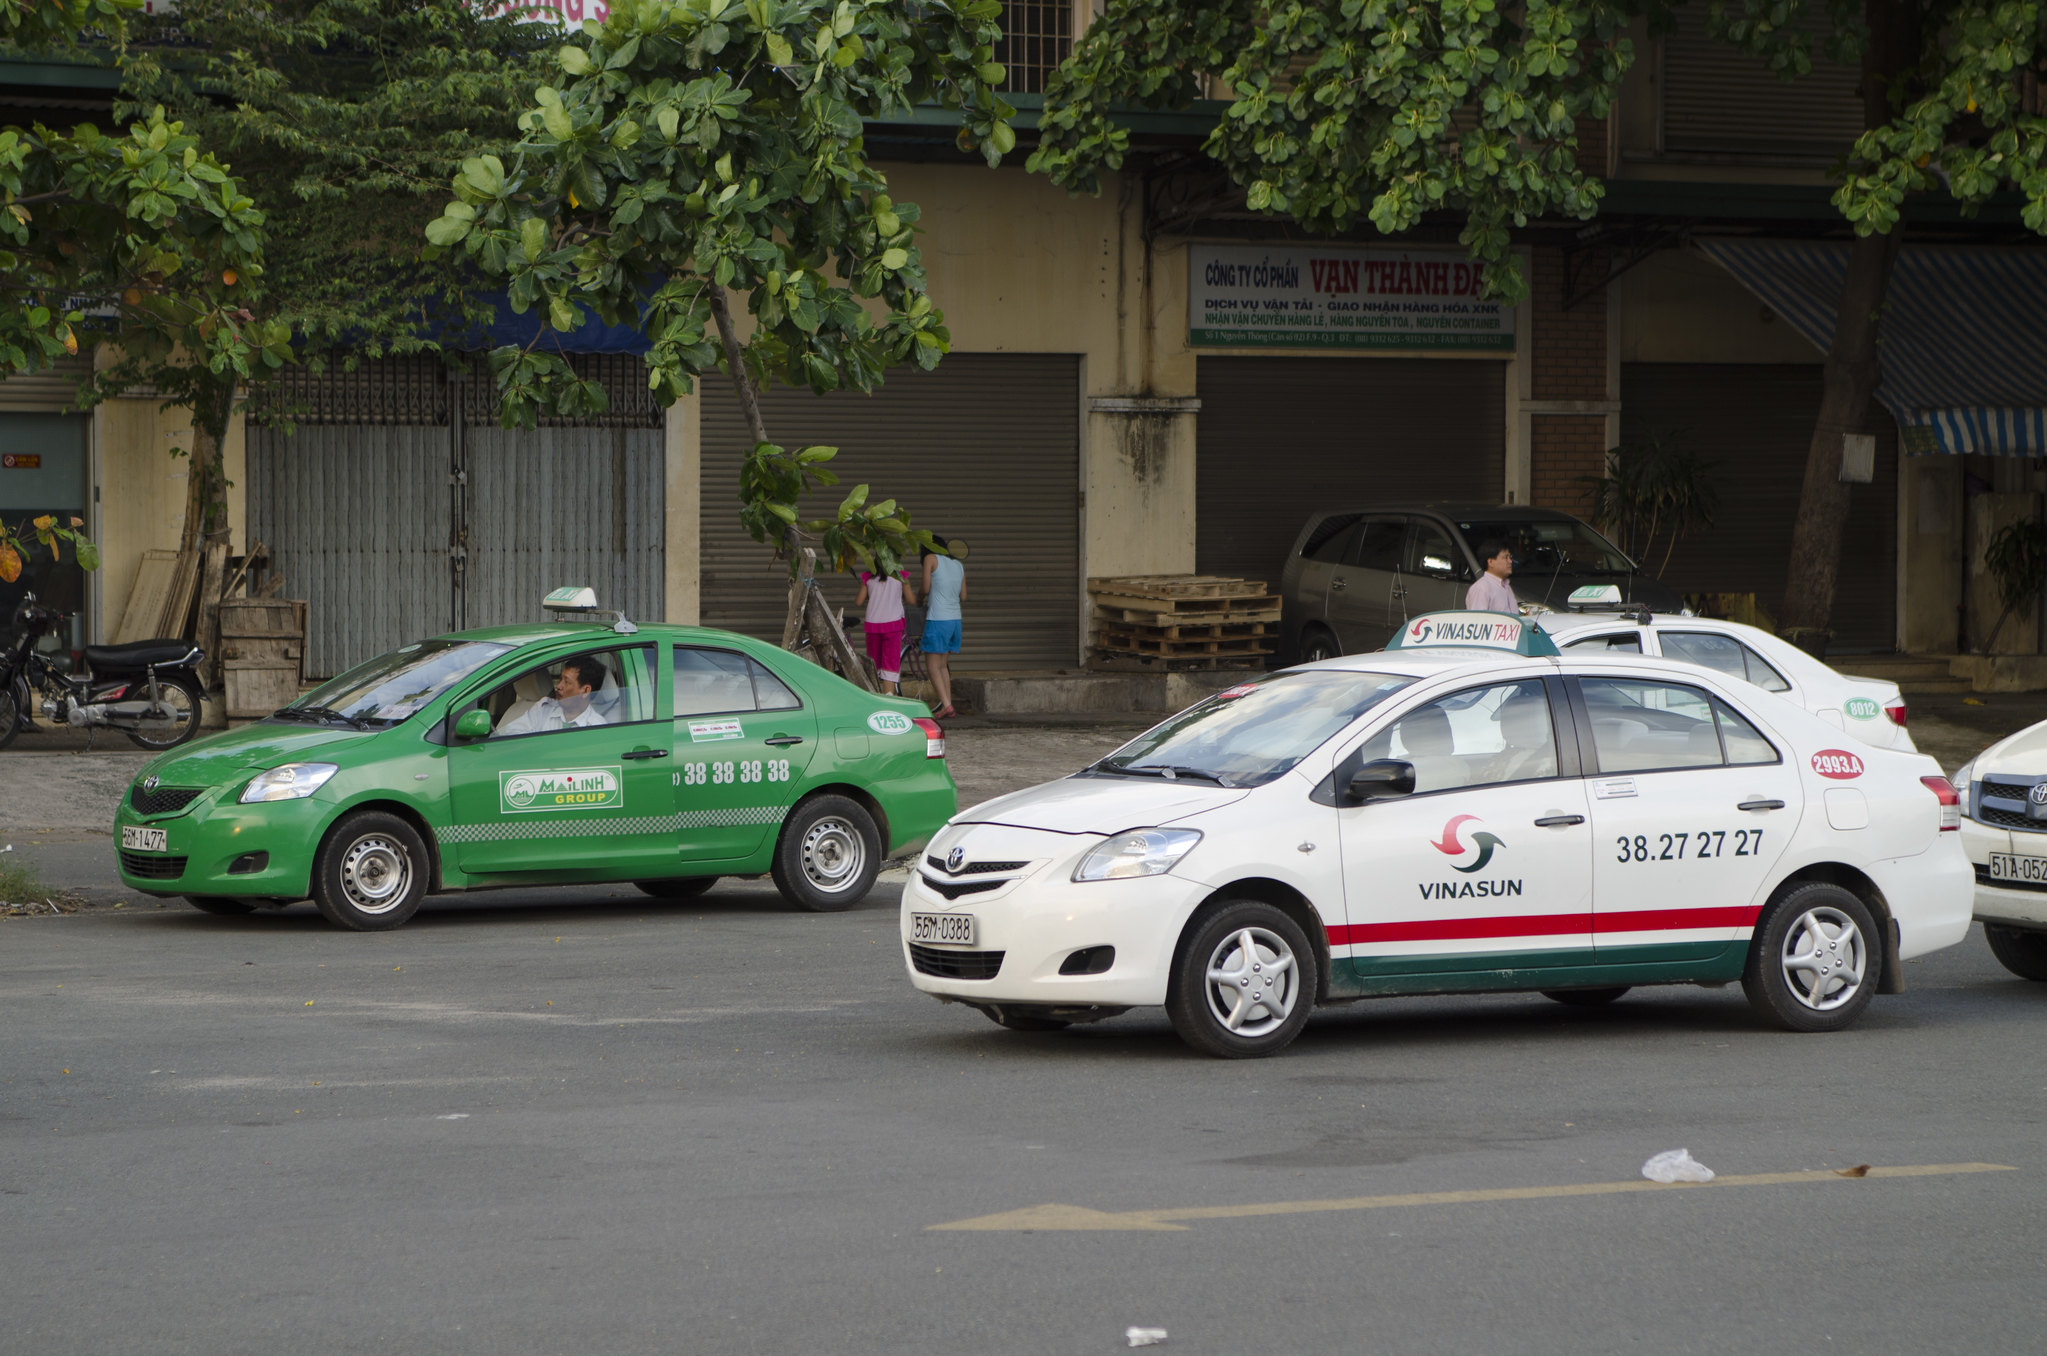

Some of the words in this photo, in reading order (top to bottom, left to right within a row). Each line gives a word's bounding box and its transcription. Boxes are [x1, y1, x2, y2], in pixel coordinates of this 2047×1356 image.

[1205, 259, 1235, 286] CÔNG
[1237, 264, 1252, 288] TY
[1253, 255, 1269, 288] CỔ
[1309, 258, 1361, 299] VẠN
[1363, 253, 1450, 296] THÀNH
[1204, 299, 1238, 312] DỊCH
[1241, 300, 1260, 313] VỤ
[1262, 298, 1289, 313] VẬN
[1292, 297, 1314, 311] TẢI
[1327, 301, 1361, 312] GIAO
[1362, 300, 1401, 315] NHẬN
[1402, 301, 1440, 314] HÀNG
[1442, 302, 1470, 314] HÓA
[1471, 303, 1501, 314] XNK
[1204, 310, 1231, 327] NHẬN
[1231, 310, 1250, 327] VẬN
[1287, 311, 1312, 327] HÀNG
[1329, 312, 1354, 328] HÀNG
[1355, 313, 1391, 329] NGUYÊN
[1415, 315, 1452, 329] NGUYÊN
[1452, 316, 1501, 329] CONTAINER
[1435, 622, 1494, 641] VINASUN
[1493, 624, 1520, 642] TAXI
[1849, 701, 1876, 716] 8012
[873, 715, 907, 729] 1255
[684, 762, 707, 786] 38
[712, 761, 735, 785] 38
[740, 760, 762, 784] 38
[767, 759, 790, 783] 38
[1812, 754, 1863, 774] 2993.A
[555, 792, 606, 804] GROUP
[1616, 832, 1689, 863] 38.27
[1696, 830, 1726, 859] 27
[1734, 829, 1763, 856] 27
[1418, 879, 1523, 900] VINASUN
[914, 916, 971, 941] 56M-0388
